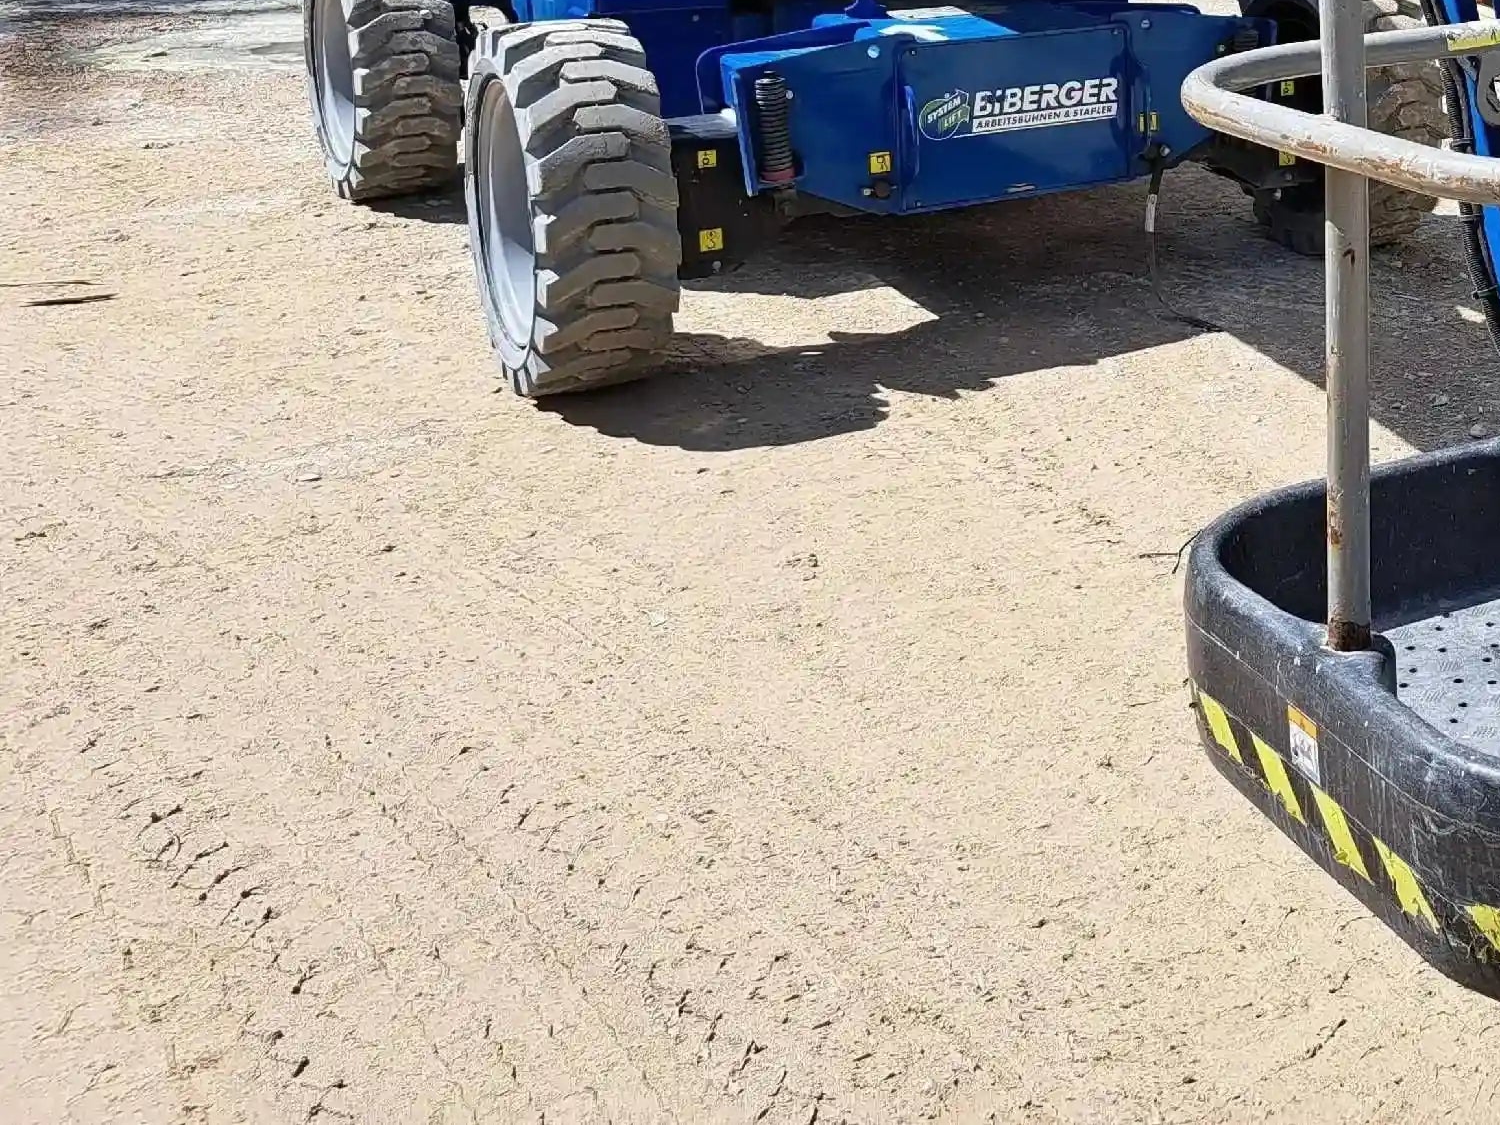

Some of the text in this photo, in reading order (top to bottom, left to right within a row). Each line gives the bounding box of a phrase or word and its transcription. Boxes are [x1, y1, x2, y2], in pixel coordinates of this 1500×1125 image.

[927, 96, 961, 124] SYSTEM
[944, 109, 963, 128] LIFT
[1073, 105, 1113, 118] STAPLER
